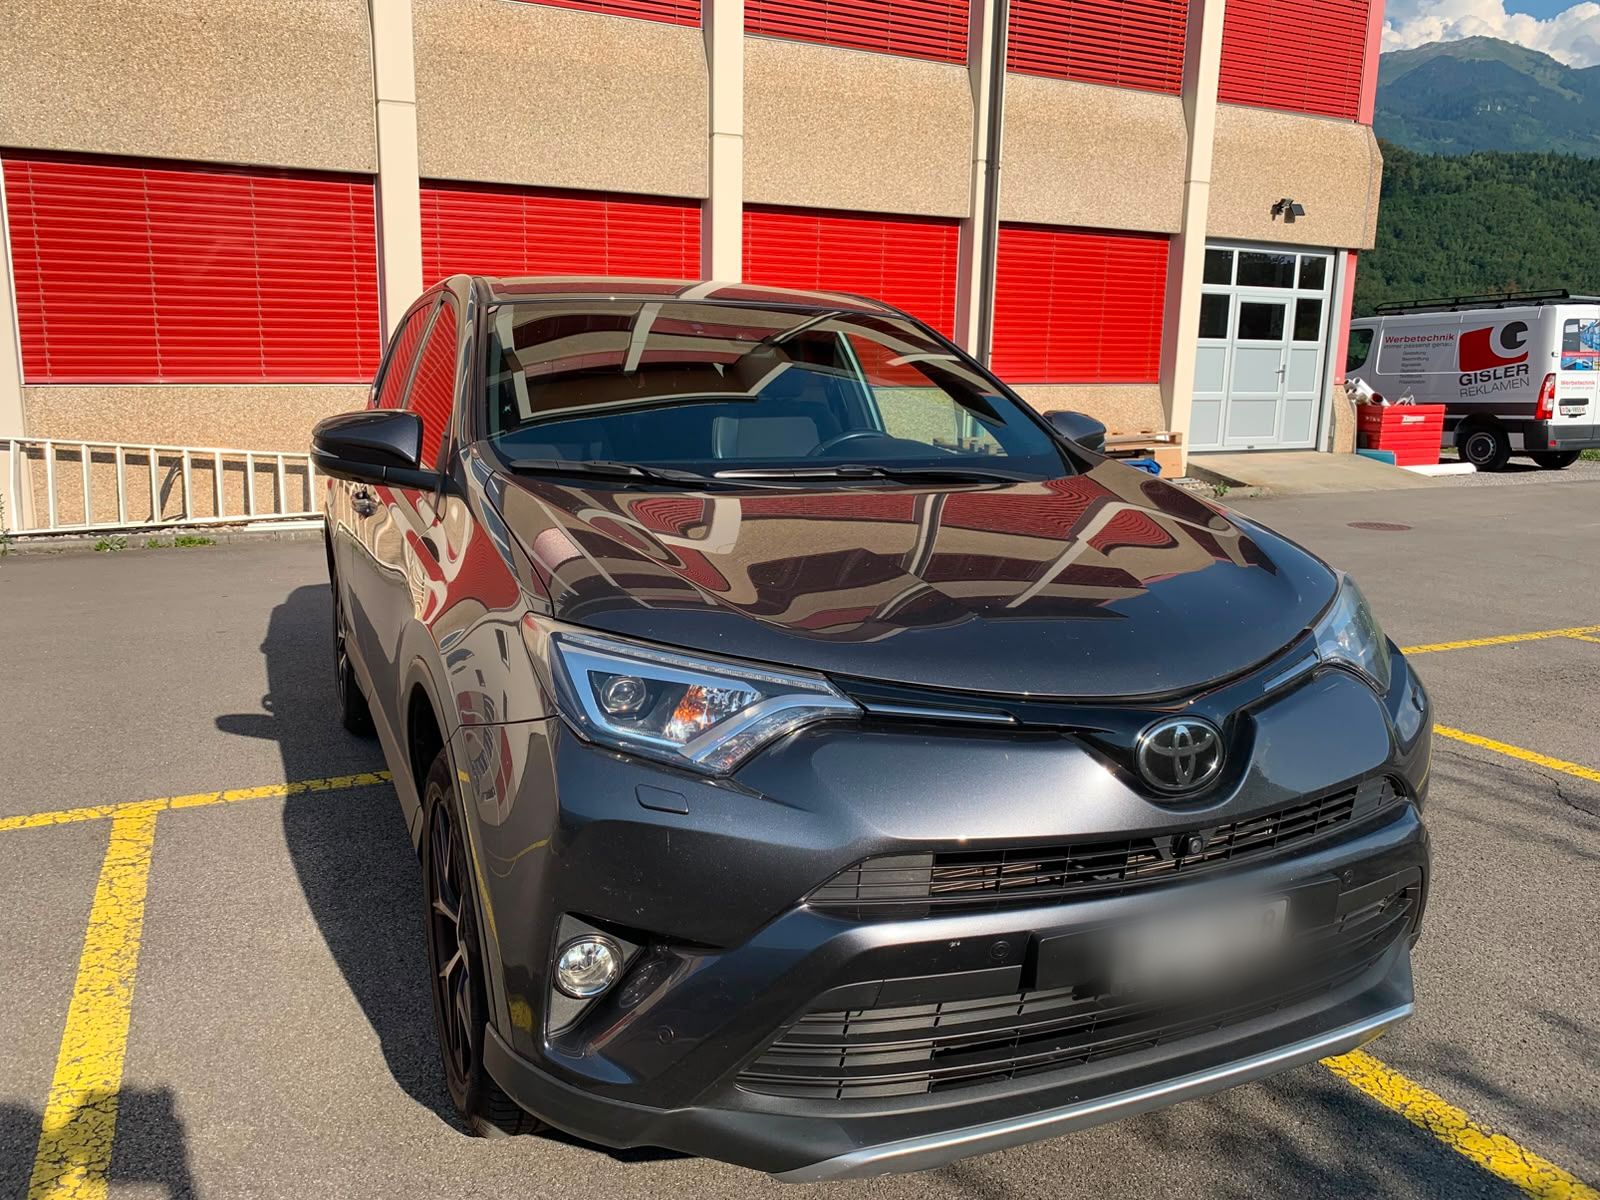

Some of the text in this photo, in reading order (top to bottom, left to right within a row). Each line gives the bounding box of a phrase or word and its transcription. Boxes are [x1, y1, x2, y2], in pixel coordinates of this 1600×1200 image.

[1385, 333, 1455, 344] Werbetechnik
[1459, 363, 1529, 386] GISLER
[1460, 377, 1530, 398] REKLAMEN
